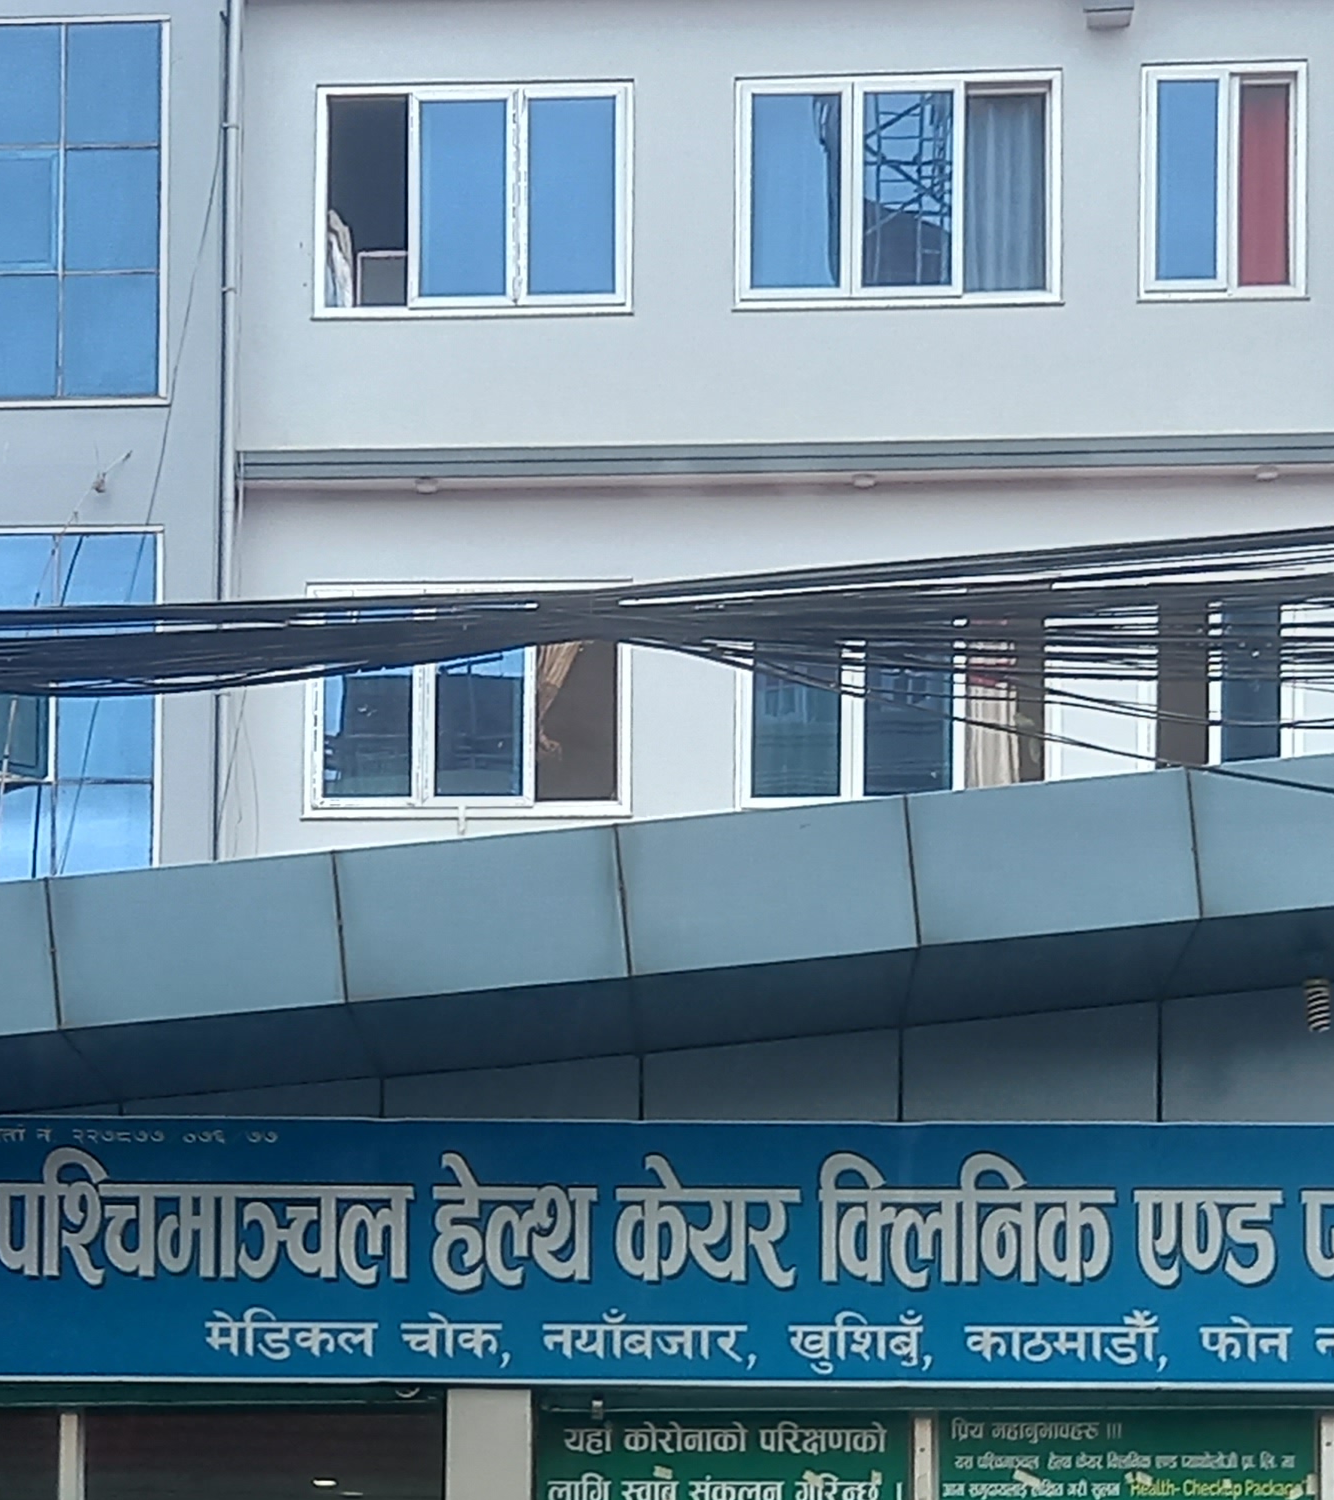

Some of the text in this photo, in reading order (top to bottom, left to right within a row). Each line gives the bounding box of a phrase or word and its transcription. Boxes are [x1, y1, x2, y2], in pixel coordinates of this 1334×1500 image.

[432, 1152, 598, 1291] हेल्थ
[615, 1155, 801, 1288] केयर
[818, 1153, 1116, 1289] क्लिनिक
[1133, 1189, 1284, 1286] एण्ड
[205, 1308, 377, 1362] मेडिकल
[400, 1311, 512, 1370] चोक,
[542, 1308, 760, 1371] नयाँबजार,
[1199, 1315, 1295, 1364] फोन
[623, 1421, 749, 1454] कोरोनाको
[759, 1420, 888, 1456] परिक्षणको
